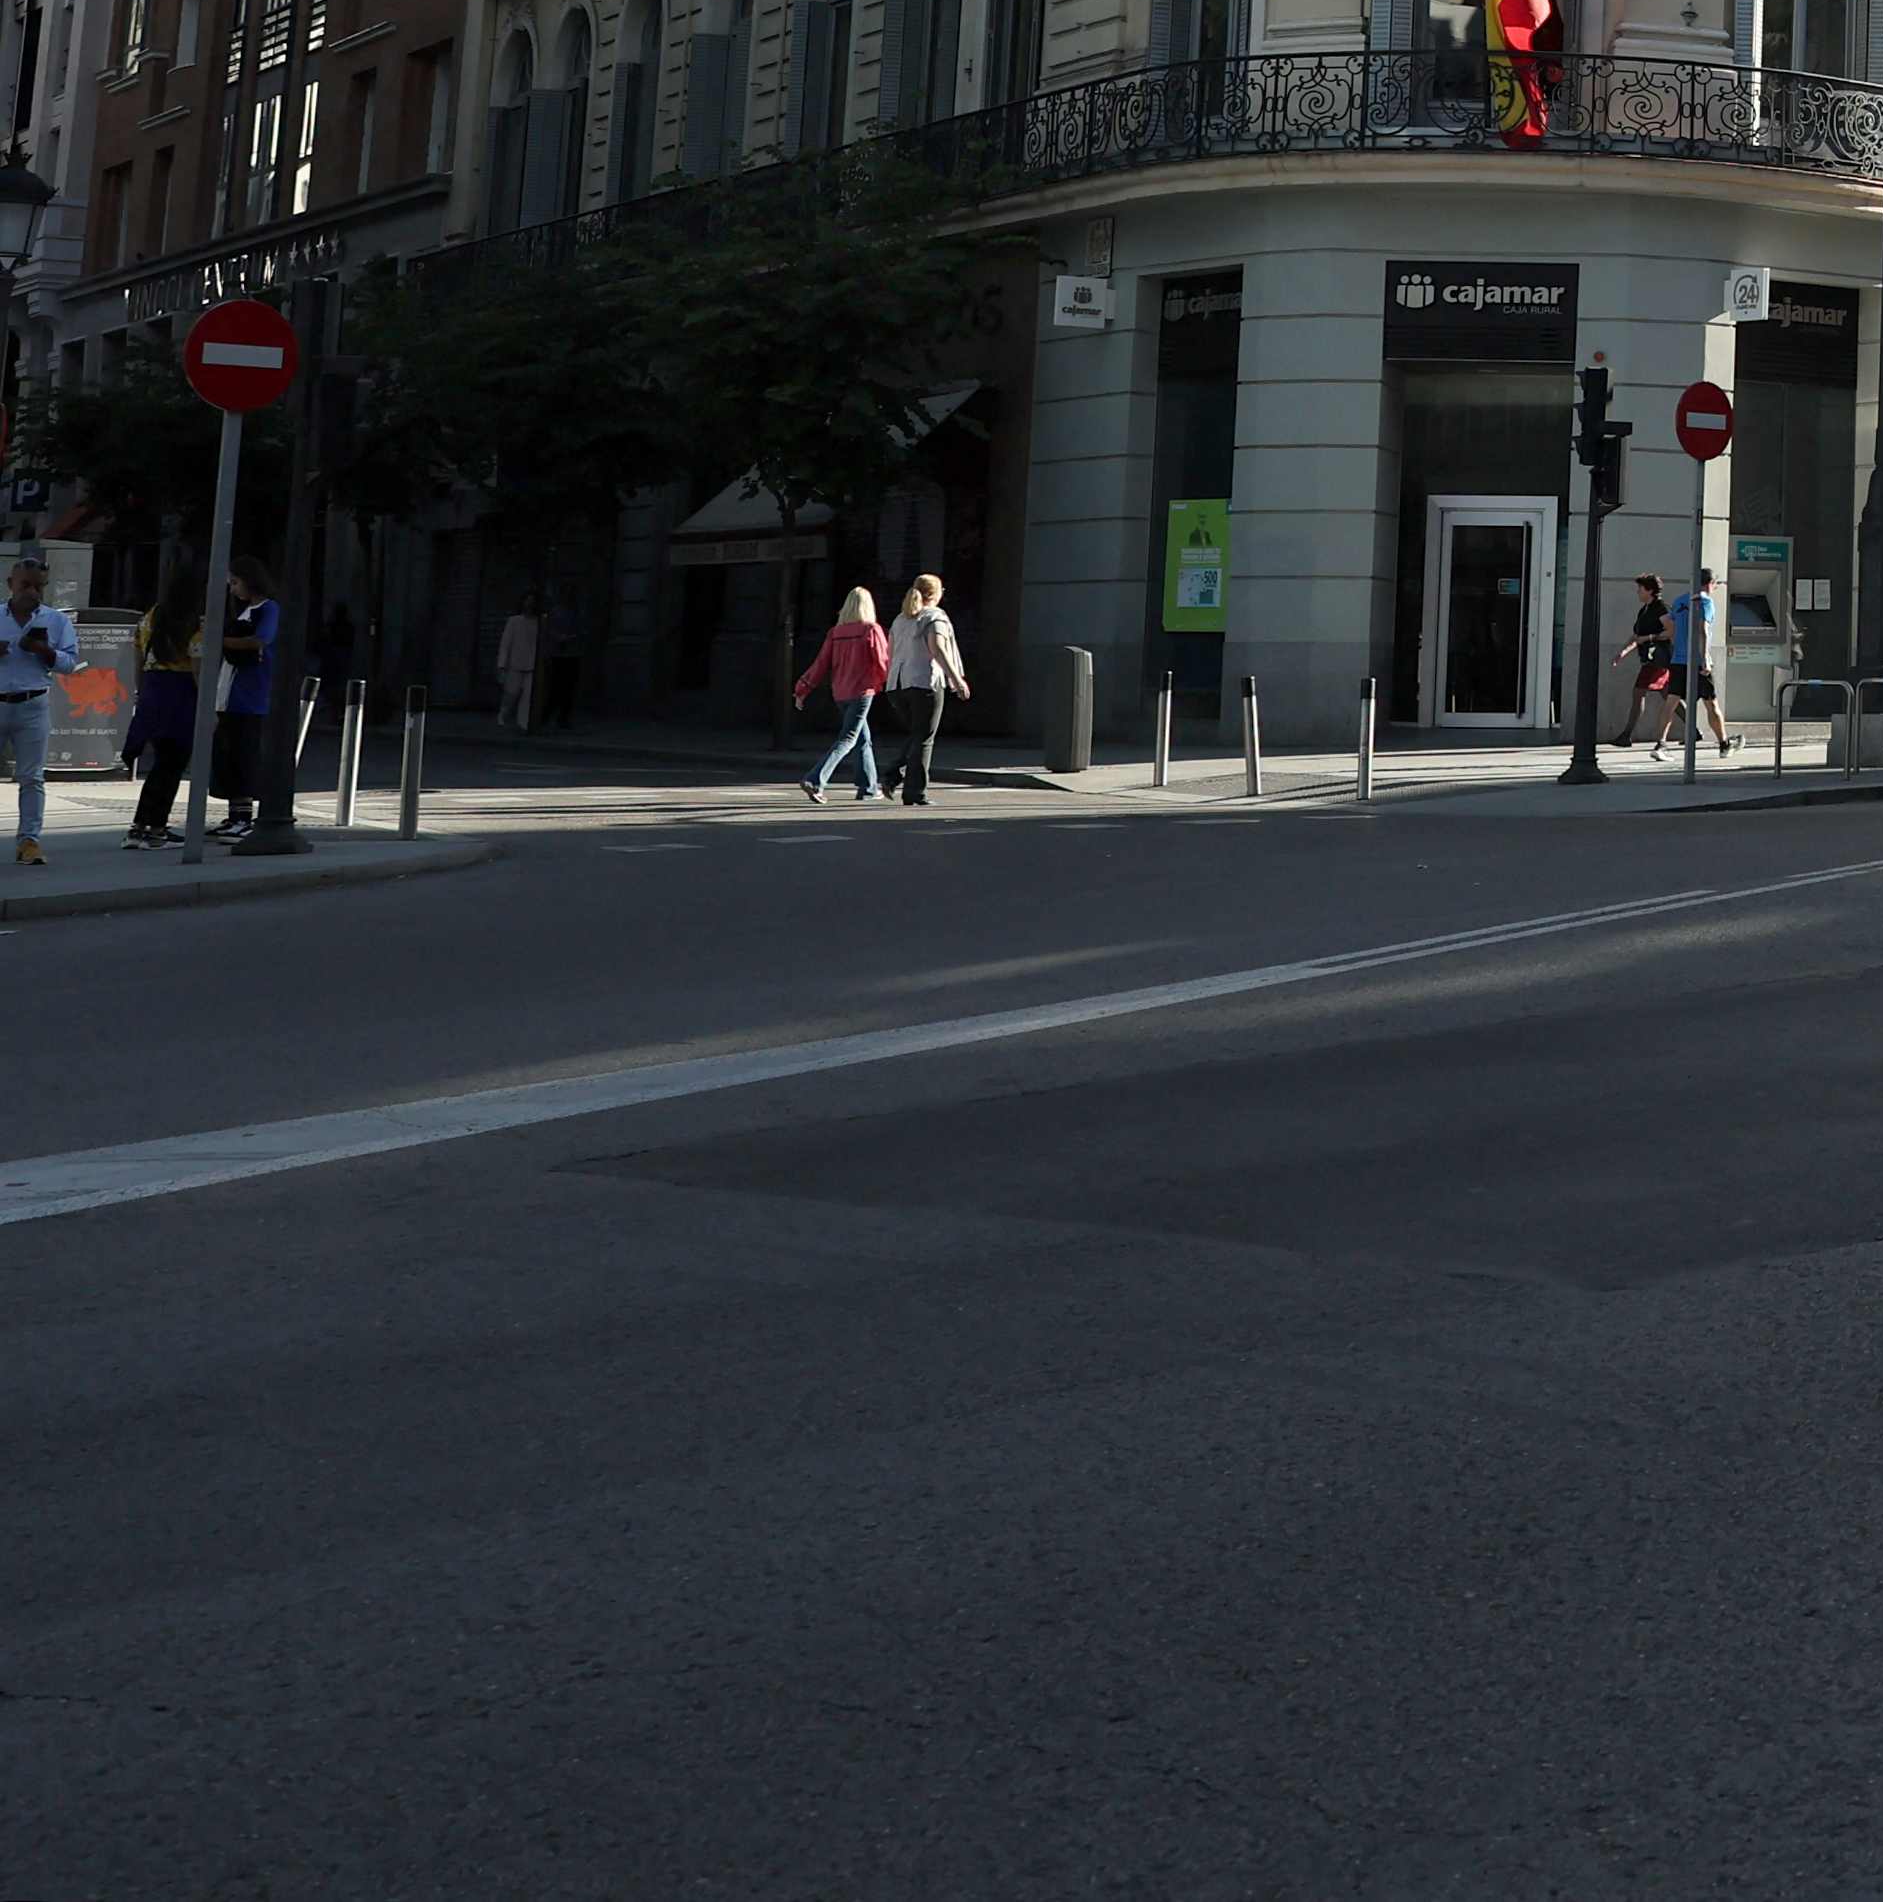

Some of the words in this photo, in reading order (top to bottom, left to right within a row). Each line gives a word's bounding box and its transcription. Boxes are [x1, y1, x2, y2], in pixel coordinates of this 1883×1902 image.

[1441, 277, 1566, 312] cajamar
[1738, 284, 1758, 305] 24
[1061, 304, 1103, 316] cajamar
[1502, 304, 1528, 315] CAJA
[1530, 305, 1564, 316] RURAL
[1770, 296, 1848, 329] ajamar
